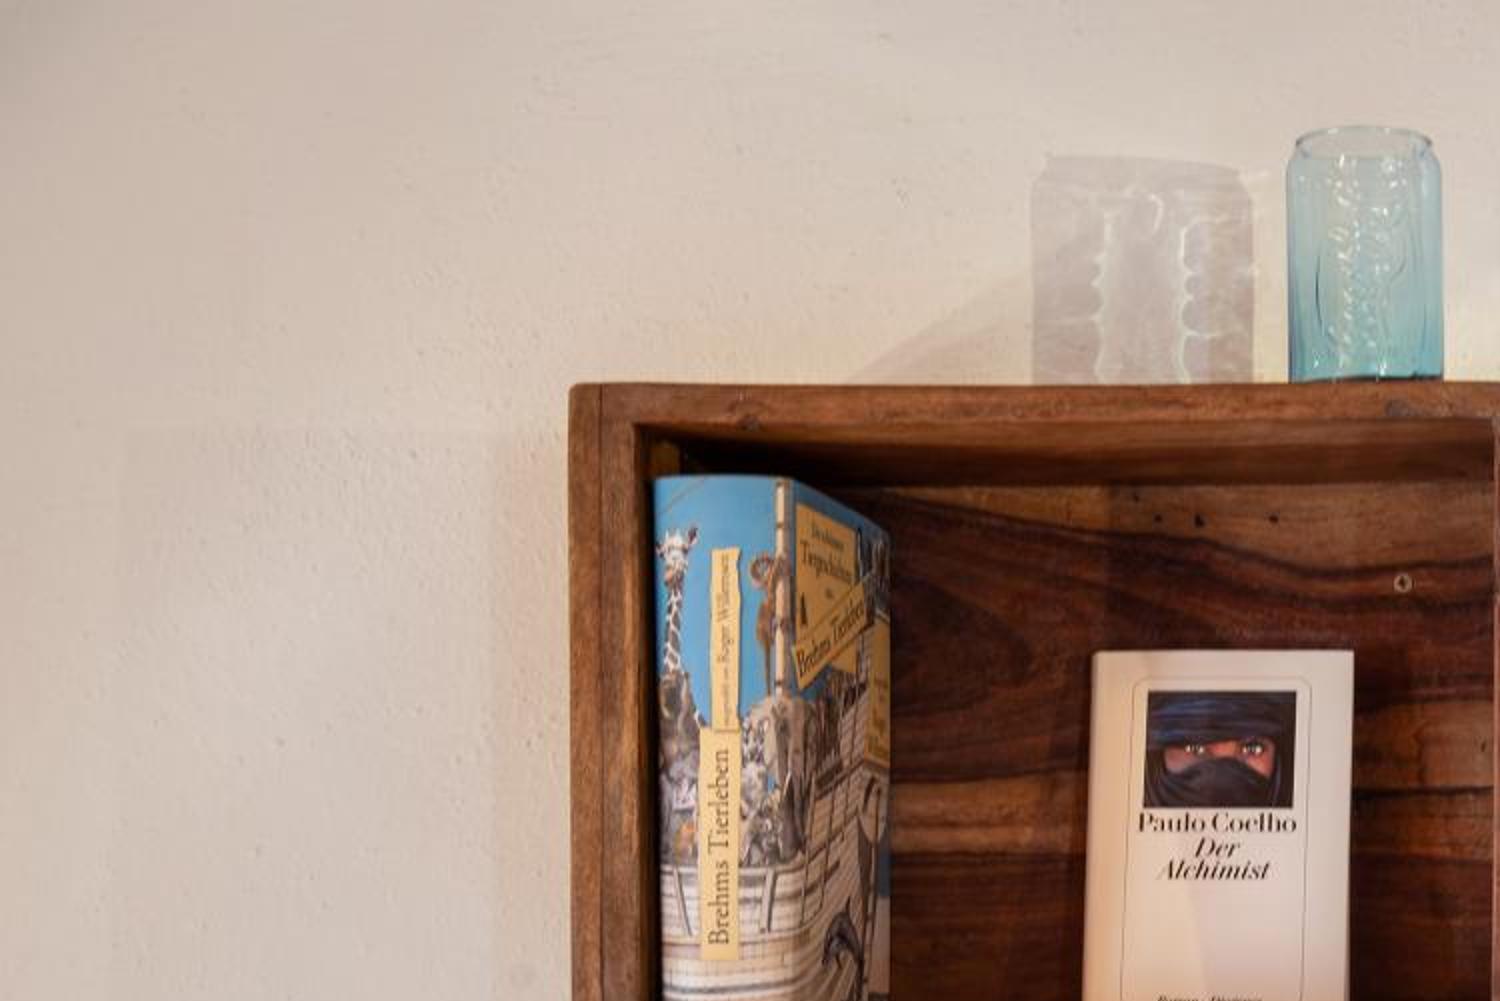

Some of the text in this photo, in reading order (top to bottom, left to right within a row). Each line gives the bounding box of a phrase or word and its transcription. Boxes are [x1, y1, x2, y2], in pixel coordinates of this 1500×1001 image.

[707, 749, 730, 854] Tierleben
[1138, 812, 1298, 833] Paulo Coelho
[1195, 837, 1241, 858] Der
[1156, 860, 1271, 881] Alchimist
[707, 859, 730, 945] Brehms
